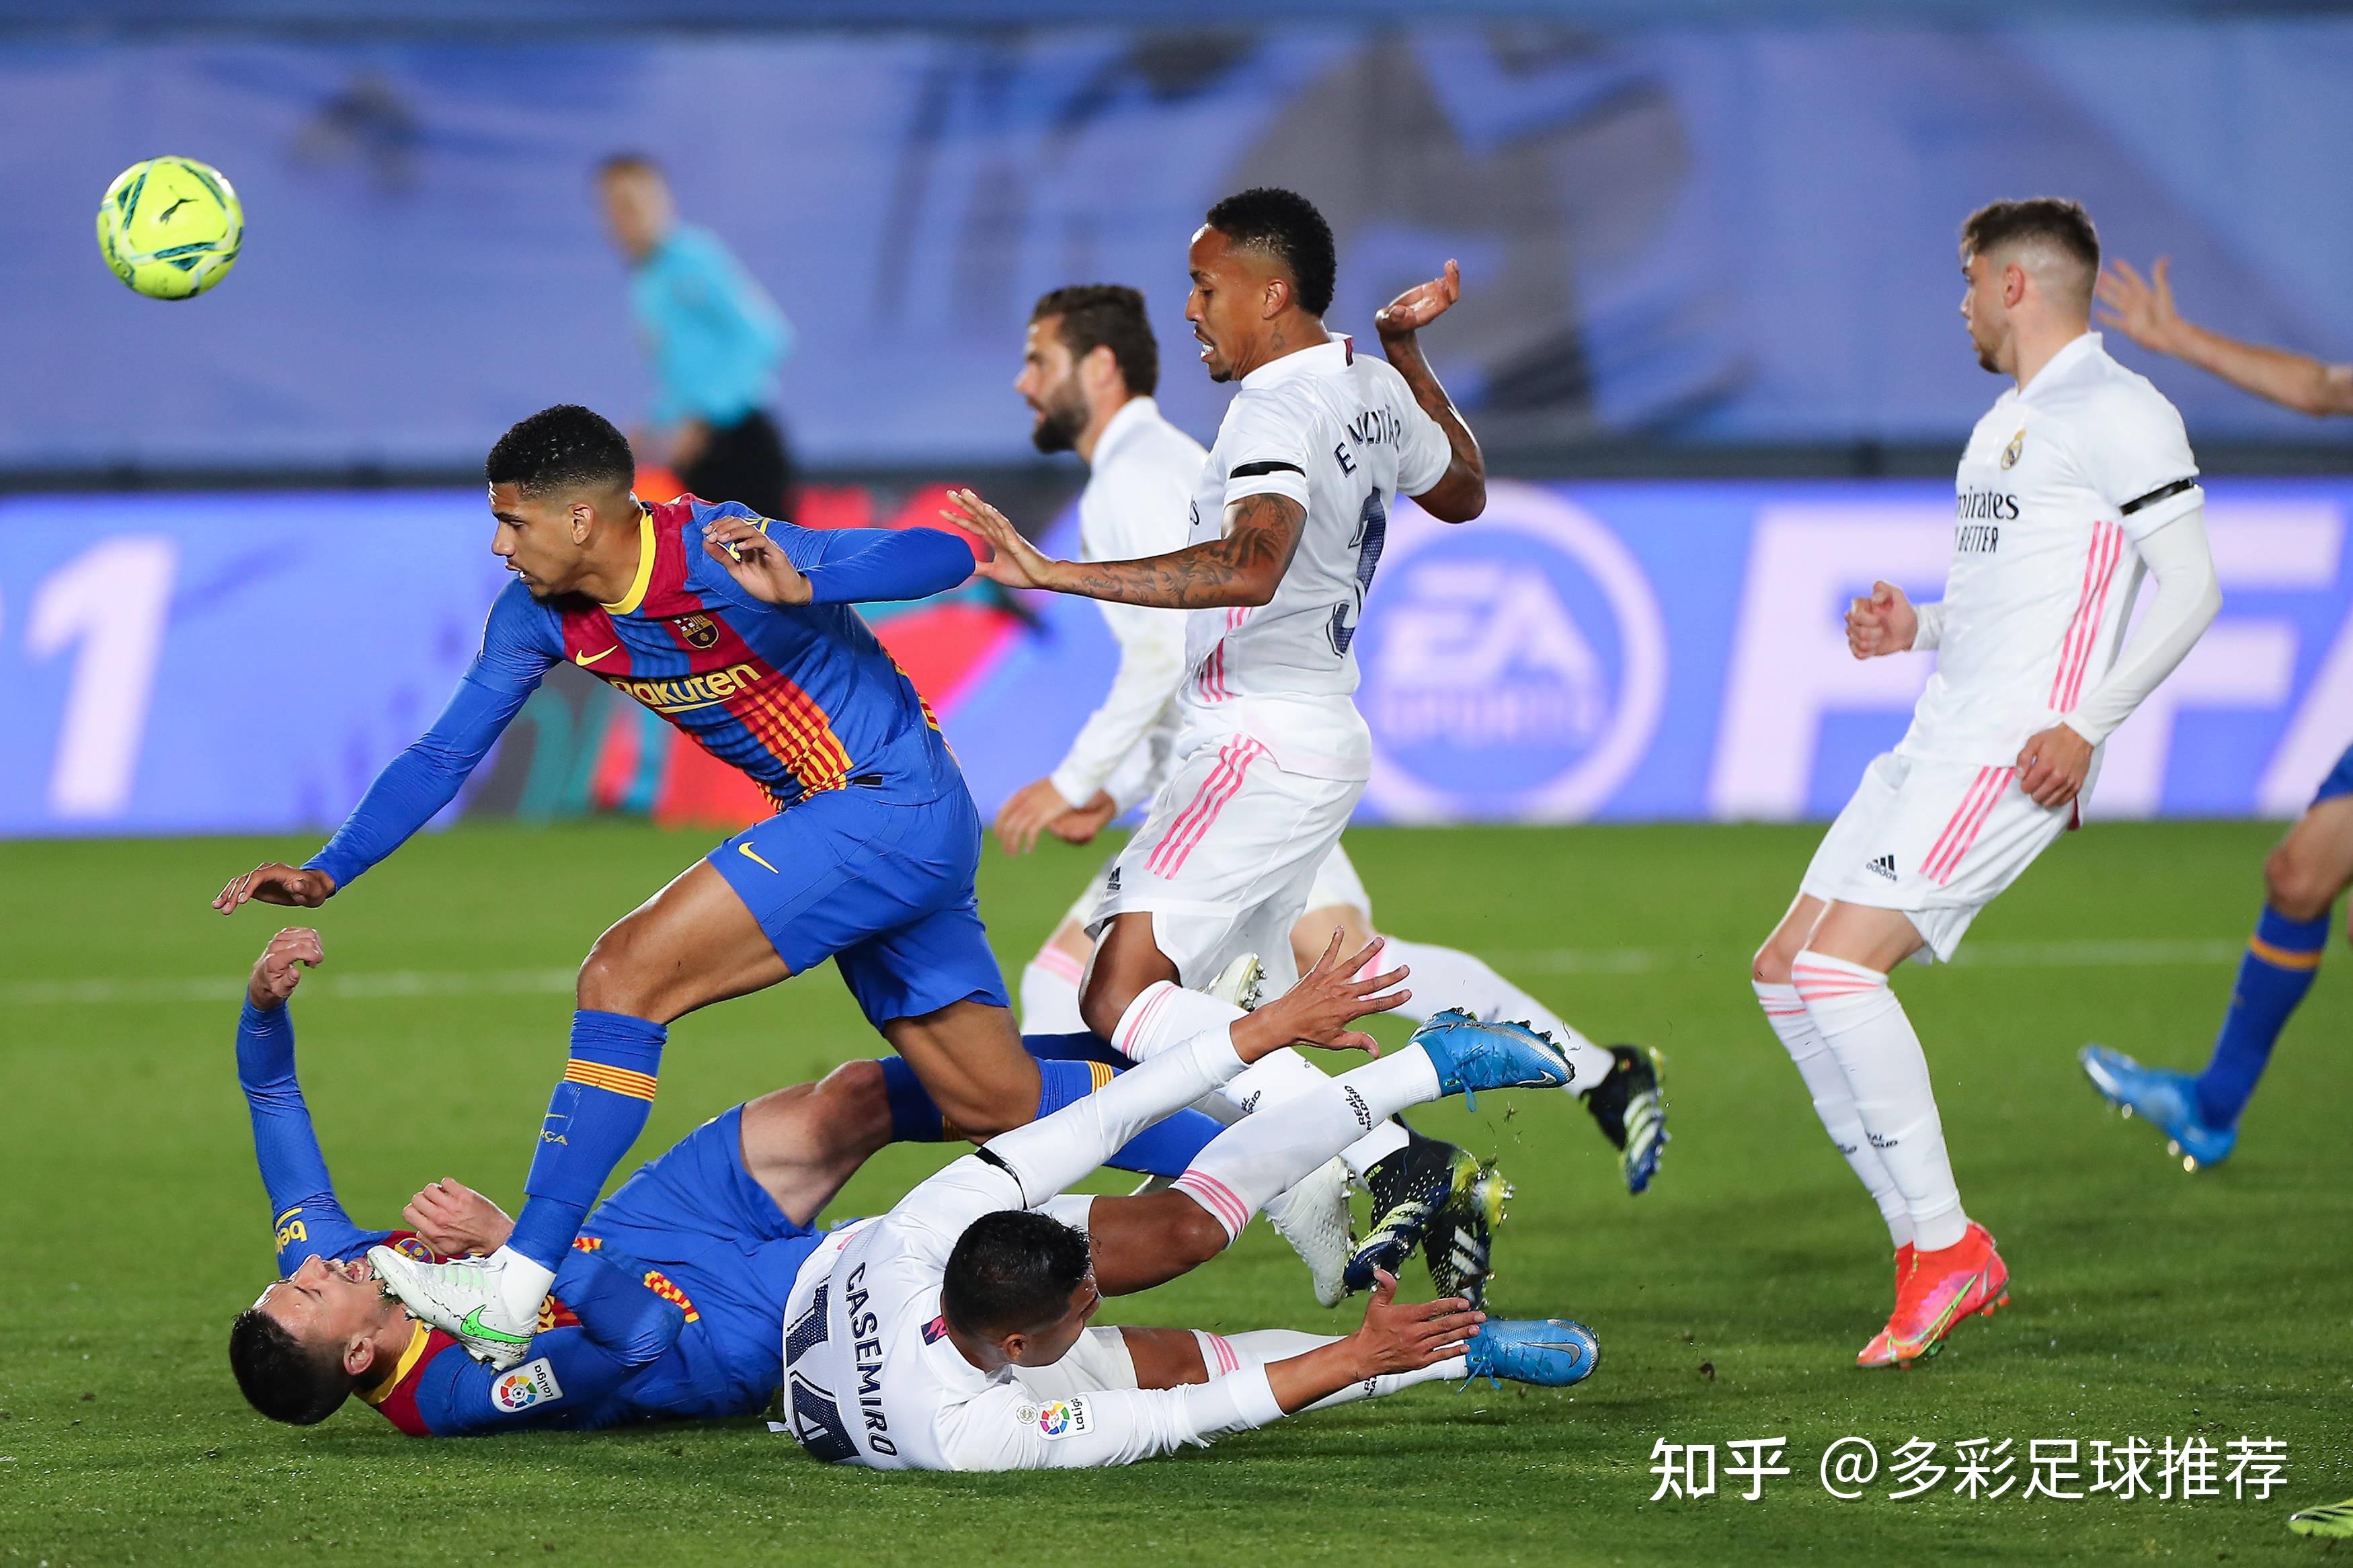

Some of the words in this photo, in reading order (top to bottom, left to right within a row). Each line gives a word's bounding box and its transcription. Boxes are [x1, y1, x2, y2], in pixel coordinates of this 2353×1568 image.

[1384, 563, 1597, 680] EA
[609, 663, 762, 706] Rakuten
[1345, 1085, 1372, 1130] MADRID
[1345, 1096, 1365, 1125] REAL
[534, 1364, 555, 1399] LaLiga
[785, 1274, 861, 1461] 14
[846, 1262, 898, 1457] CASEMIRO
[1070, 1398, 1085, 1431] LaLiga
